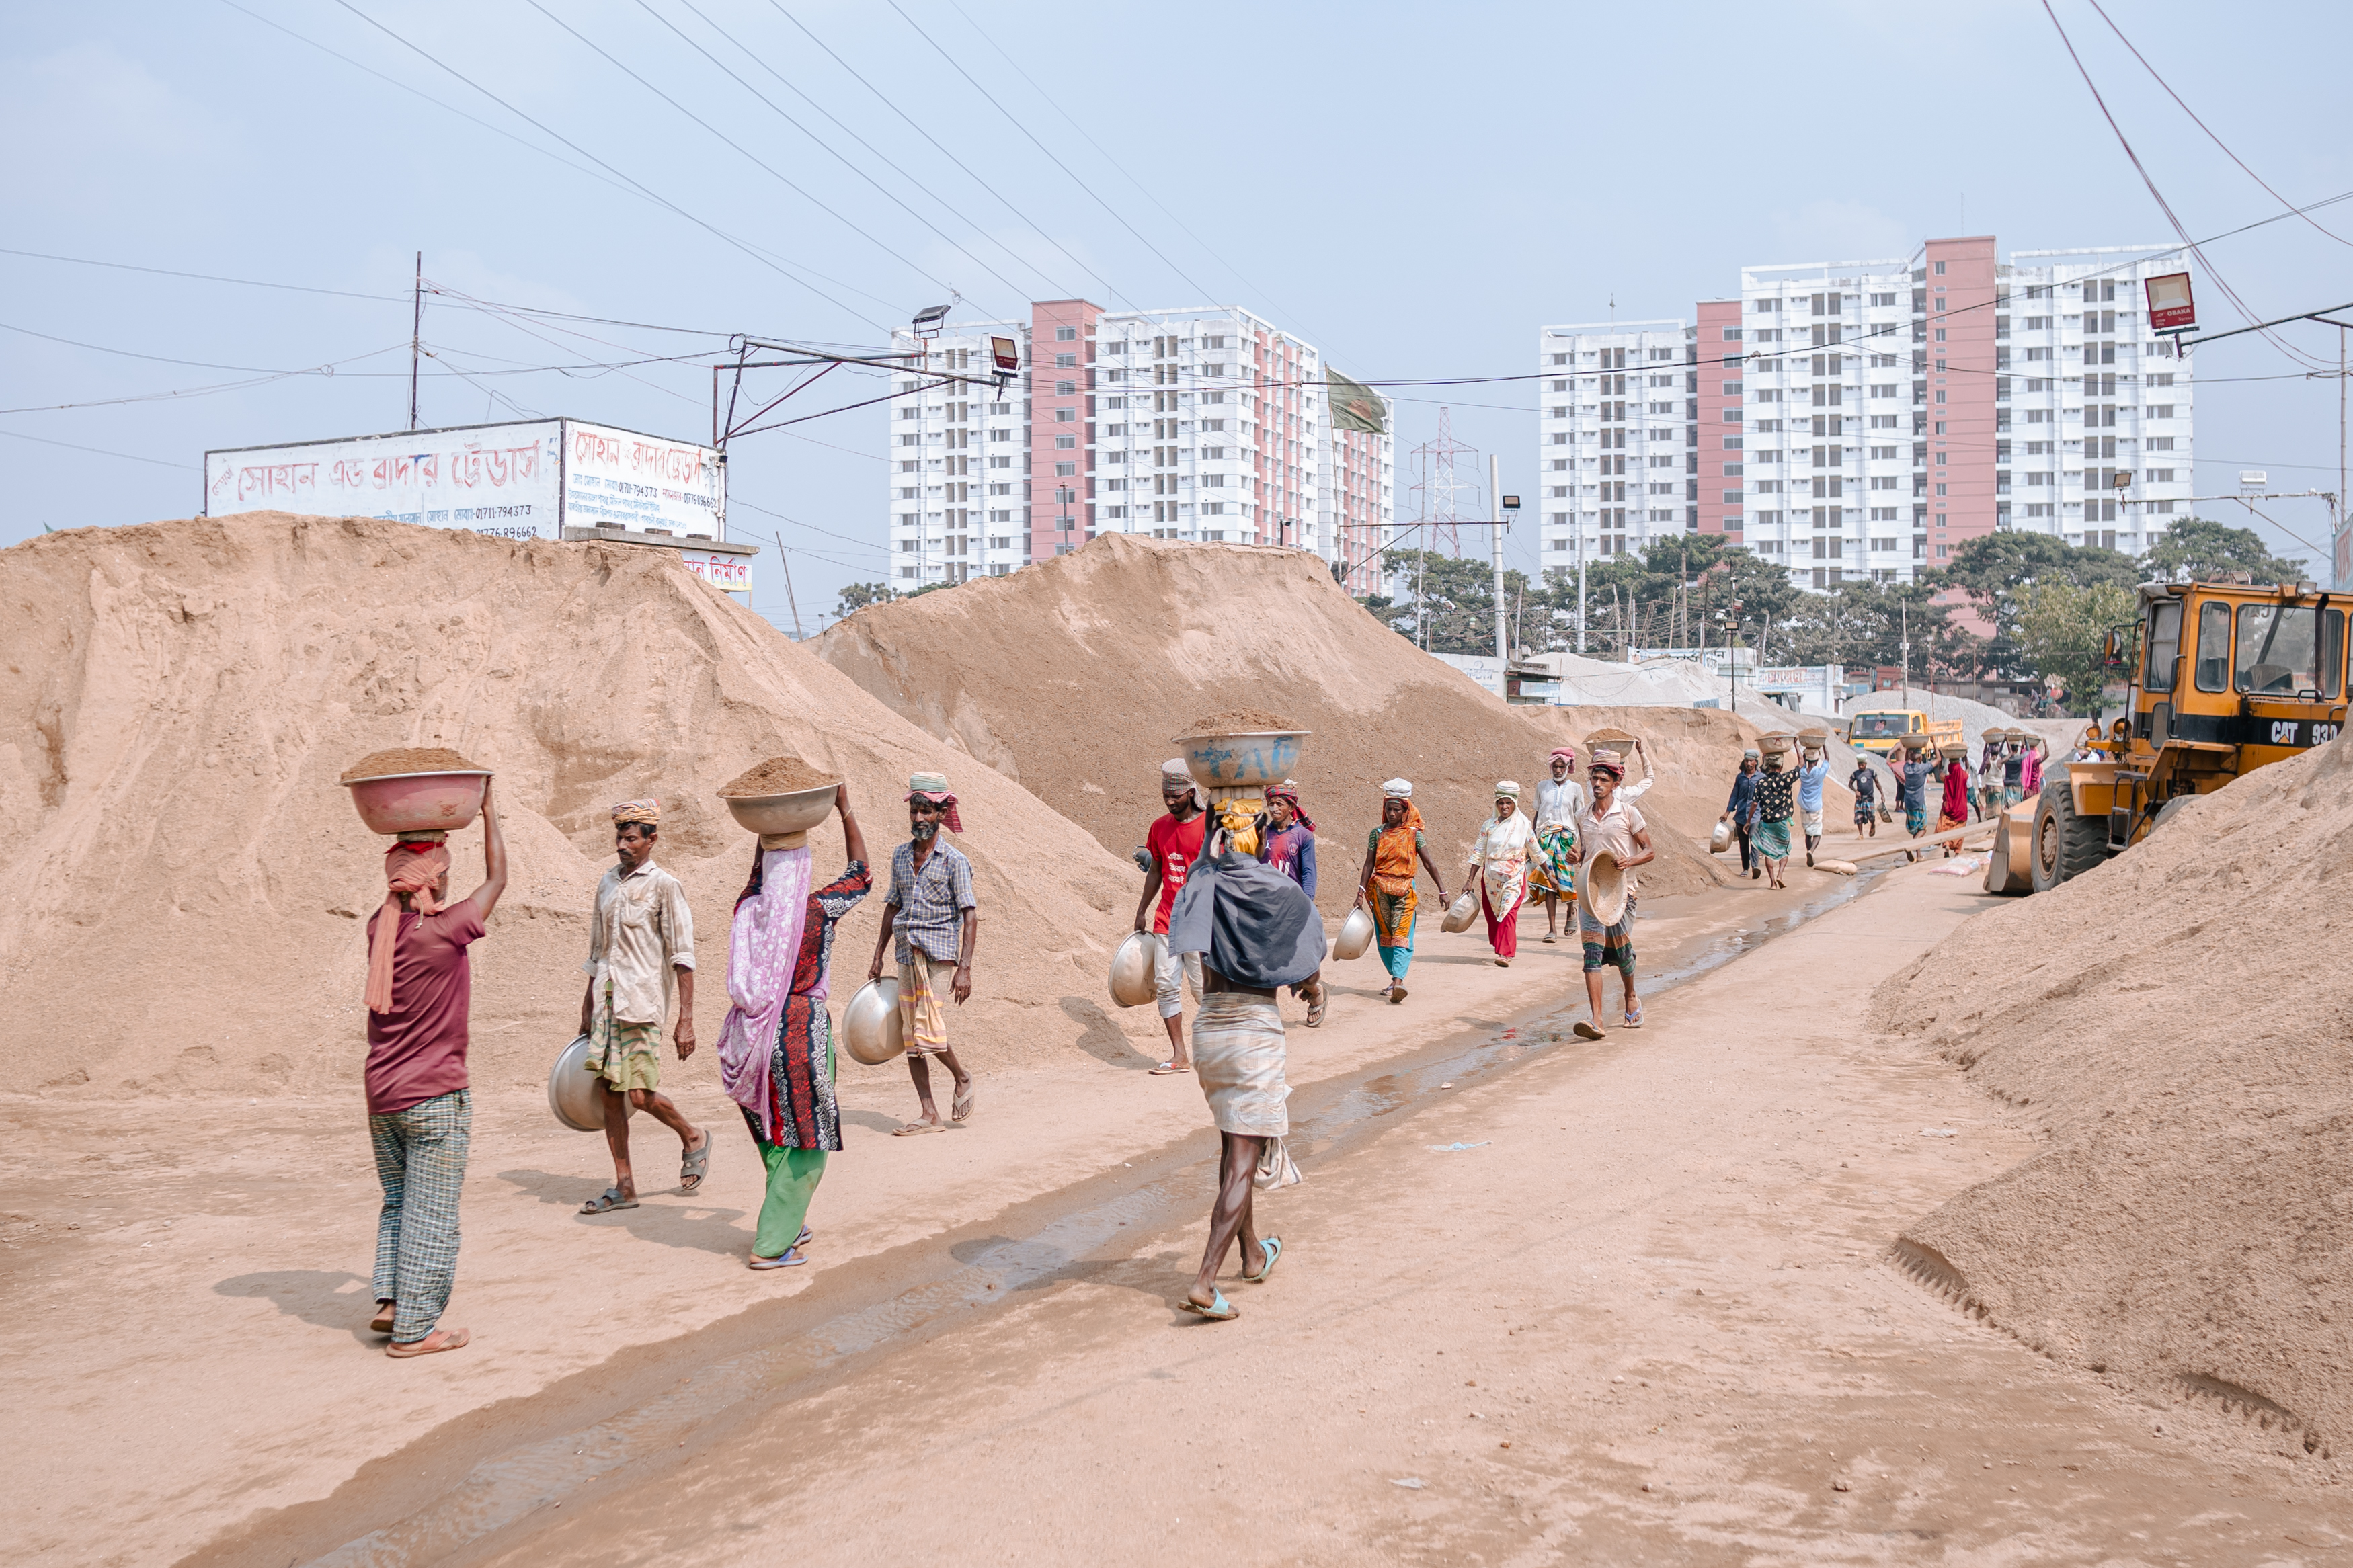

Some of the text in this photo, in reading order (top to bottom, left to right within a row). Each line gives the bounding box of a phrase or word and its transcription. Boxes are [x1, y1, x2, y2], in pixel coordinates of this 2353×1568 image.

[2167, 308, 2191, 317] OSAKA
[709, 555, 748, 587] নির্মাণ
[2271, 721, 2298, 745] CAT
